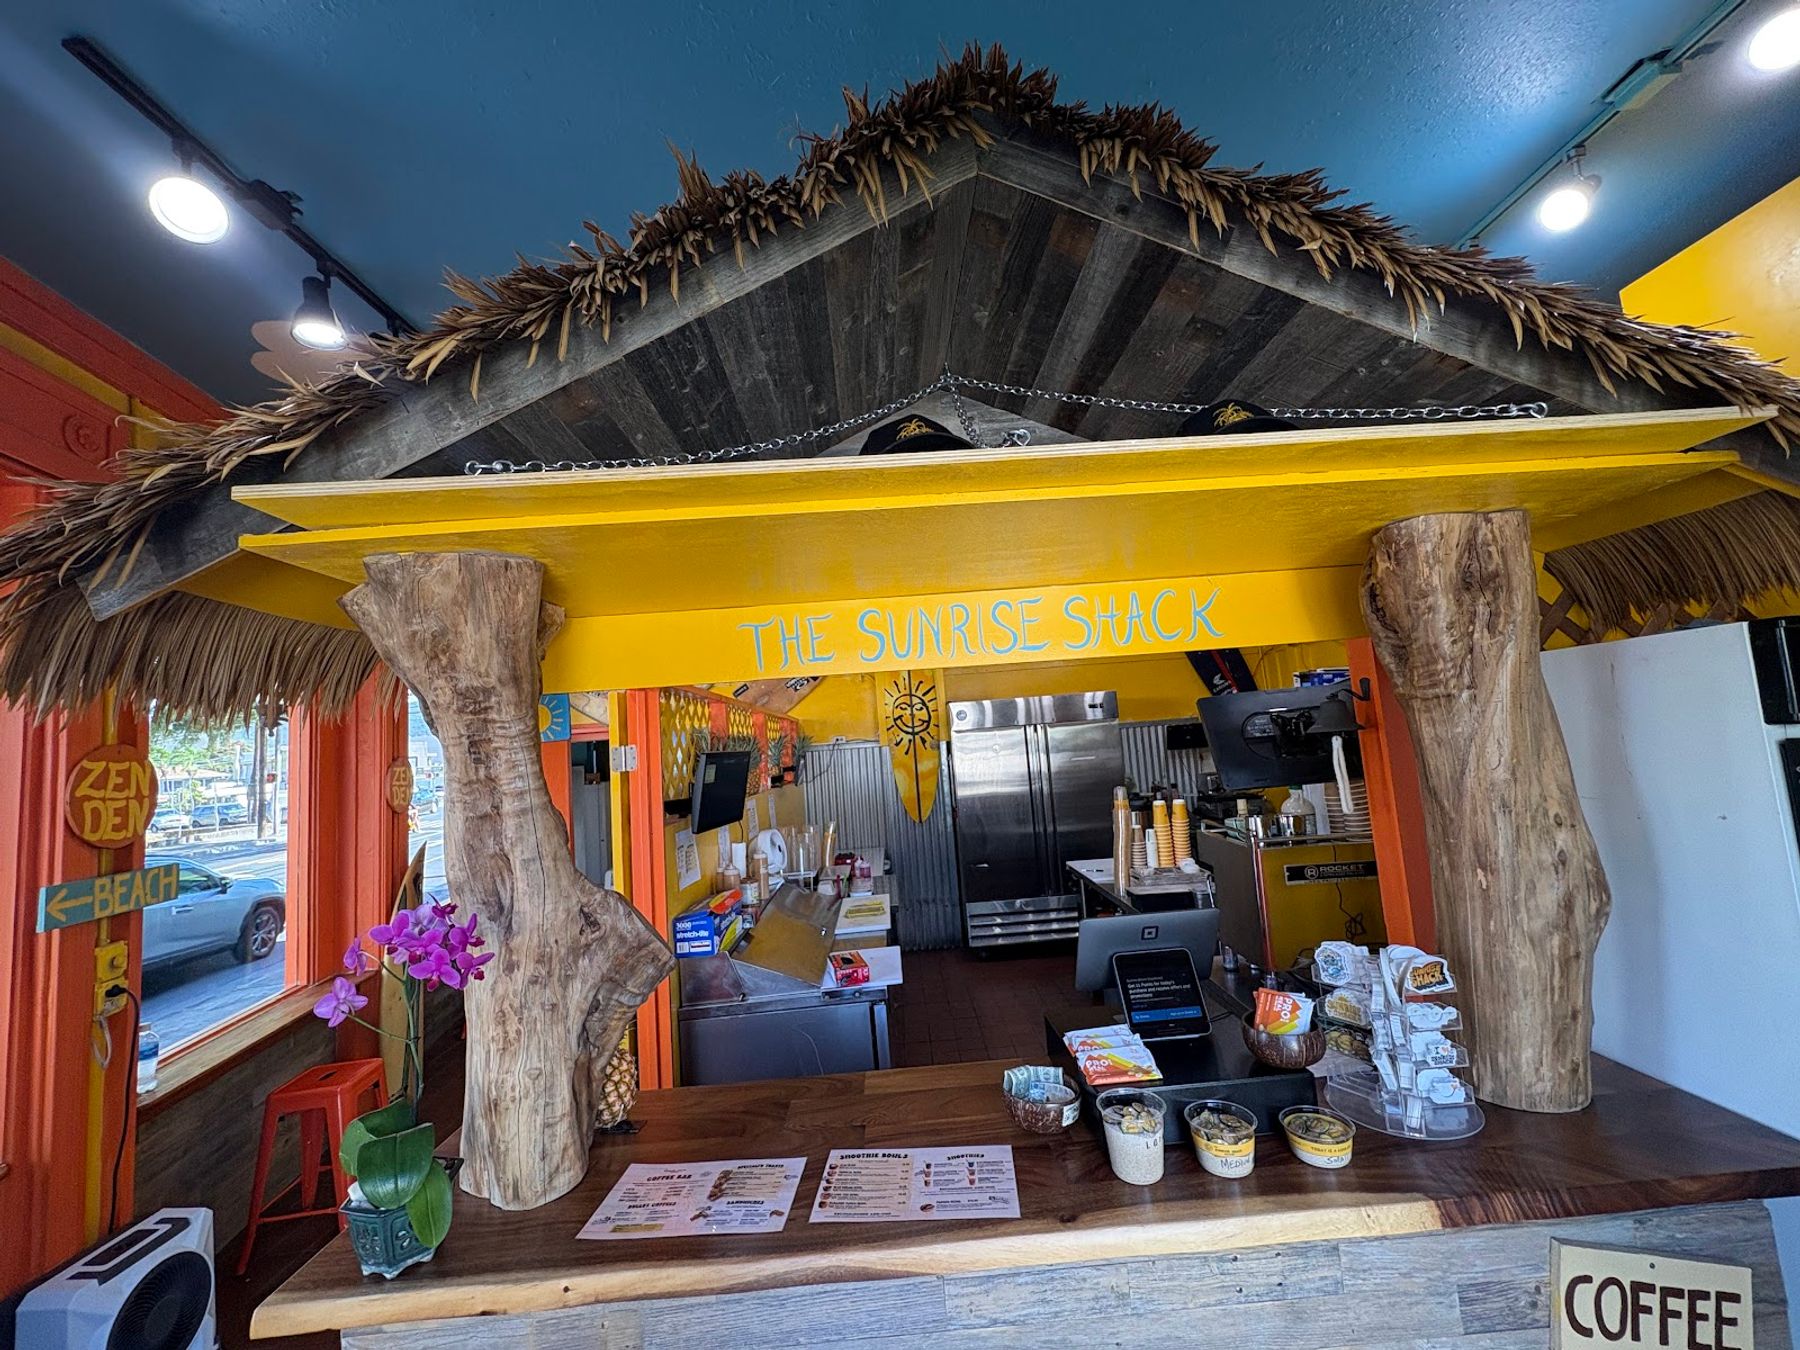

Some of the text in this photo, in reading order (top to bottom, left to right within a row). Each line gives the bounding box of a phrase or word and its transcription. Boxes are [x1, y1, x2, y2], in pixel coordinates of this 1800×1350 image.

[736, 586, 1226, 672] THE SUNRISE SHACK
[75, 760, 150, 798] ZEN
[81, 799, 150, 842] DEN
[1320, 864, 1365, 872] ROCKET
[93, 865, 178, 919] BEACH
[1411, 970, 1444, 988] SHACK
[947, 1153, 985, 1161] SMOOTHIES
[646, 1174, 674, 1182] COFFEE
[1564, 1274, 1742, 1350] COFFEE
